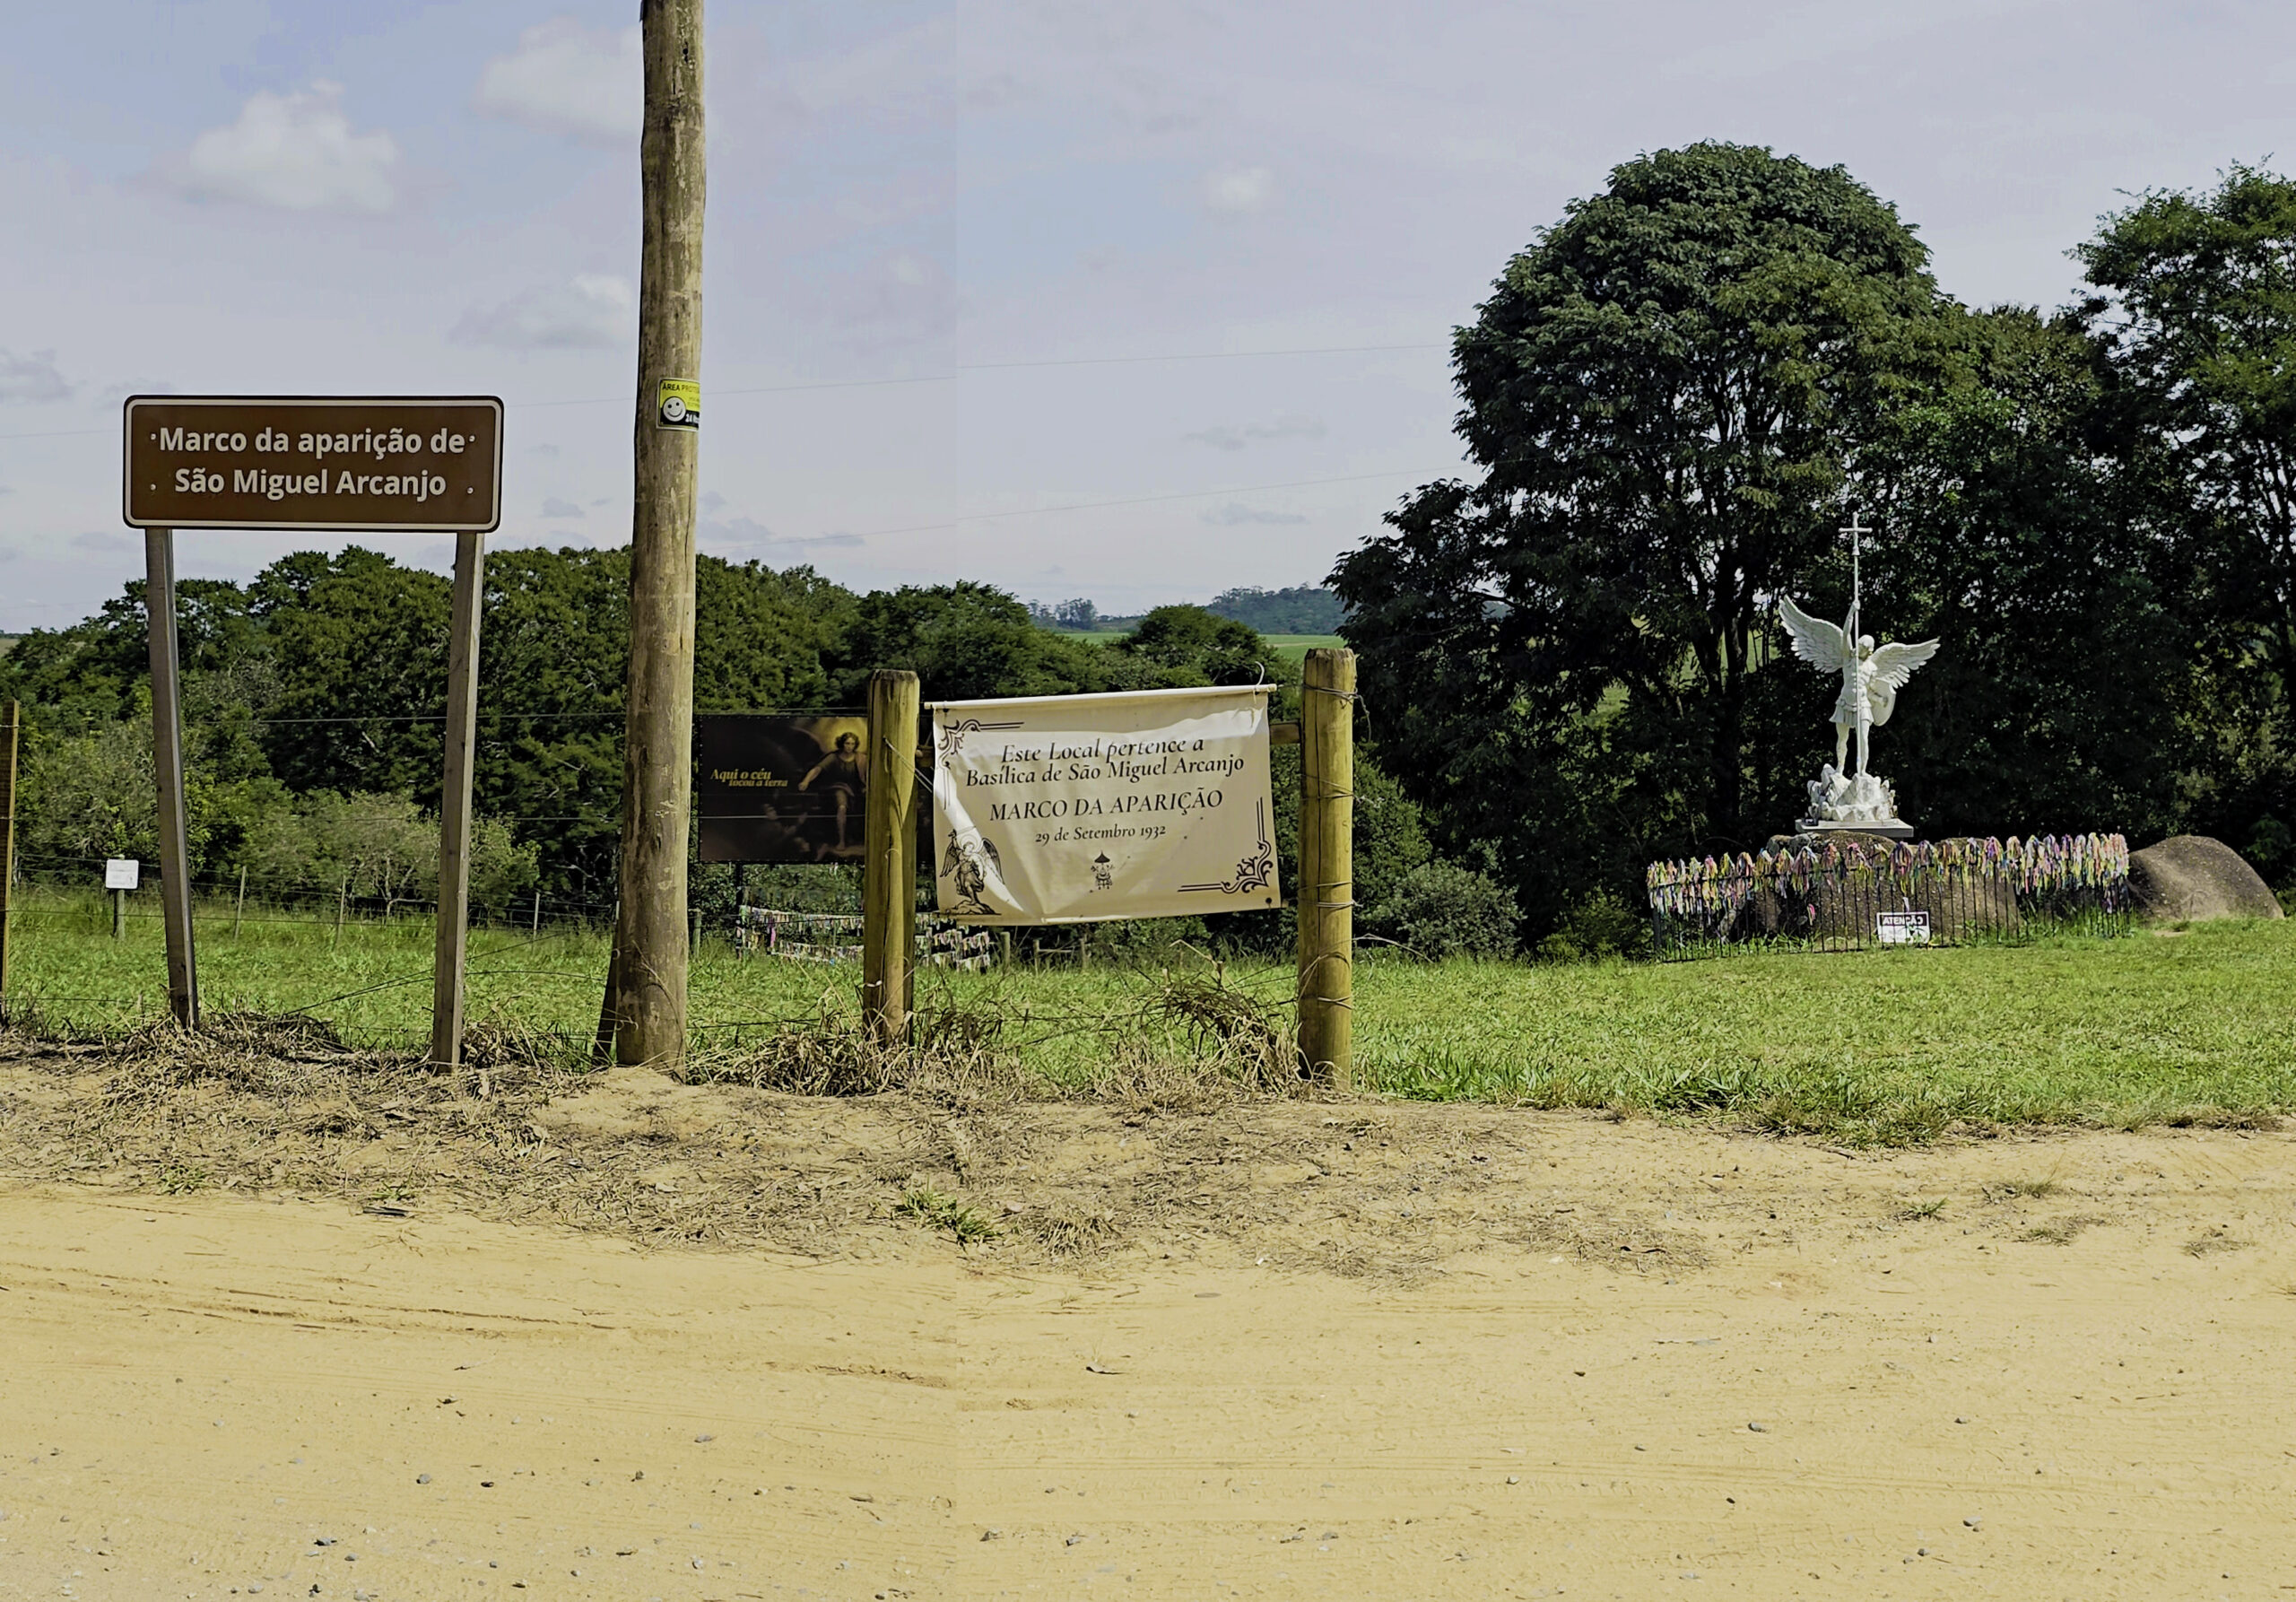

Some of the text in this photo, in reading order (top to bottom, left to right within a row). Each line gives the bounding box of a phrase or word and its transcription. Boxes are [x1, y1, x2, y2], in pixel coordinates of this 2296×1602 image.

[160, 427, 465, 460] Marco da aparição de
[175, 467, 447, 502] São Miguel Arcanjo
[1001, 738, 1204, 763] Este Local pertence a
[709, 767, 771, 783] Aqui o céu
[728, 779, 755, 787] tocou
[966, 753, 1244, 787] Basílica de São Miguel Arcanjo
[989, 787, 1223, 822] MARCO DA APARIÇÃO
[1035, 823, 1166, 847] 29 de Setembro 1932
